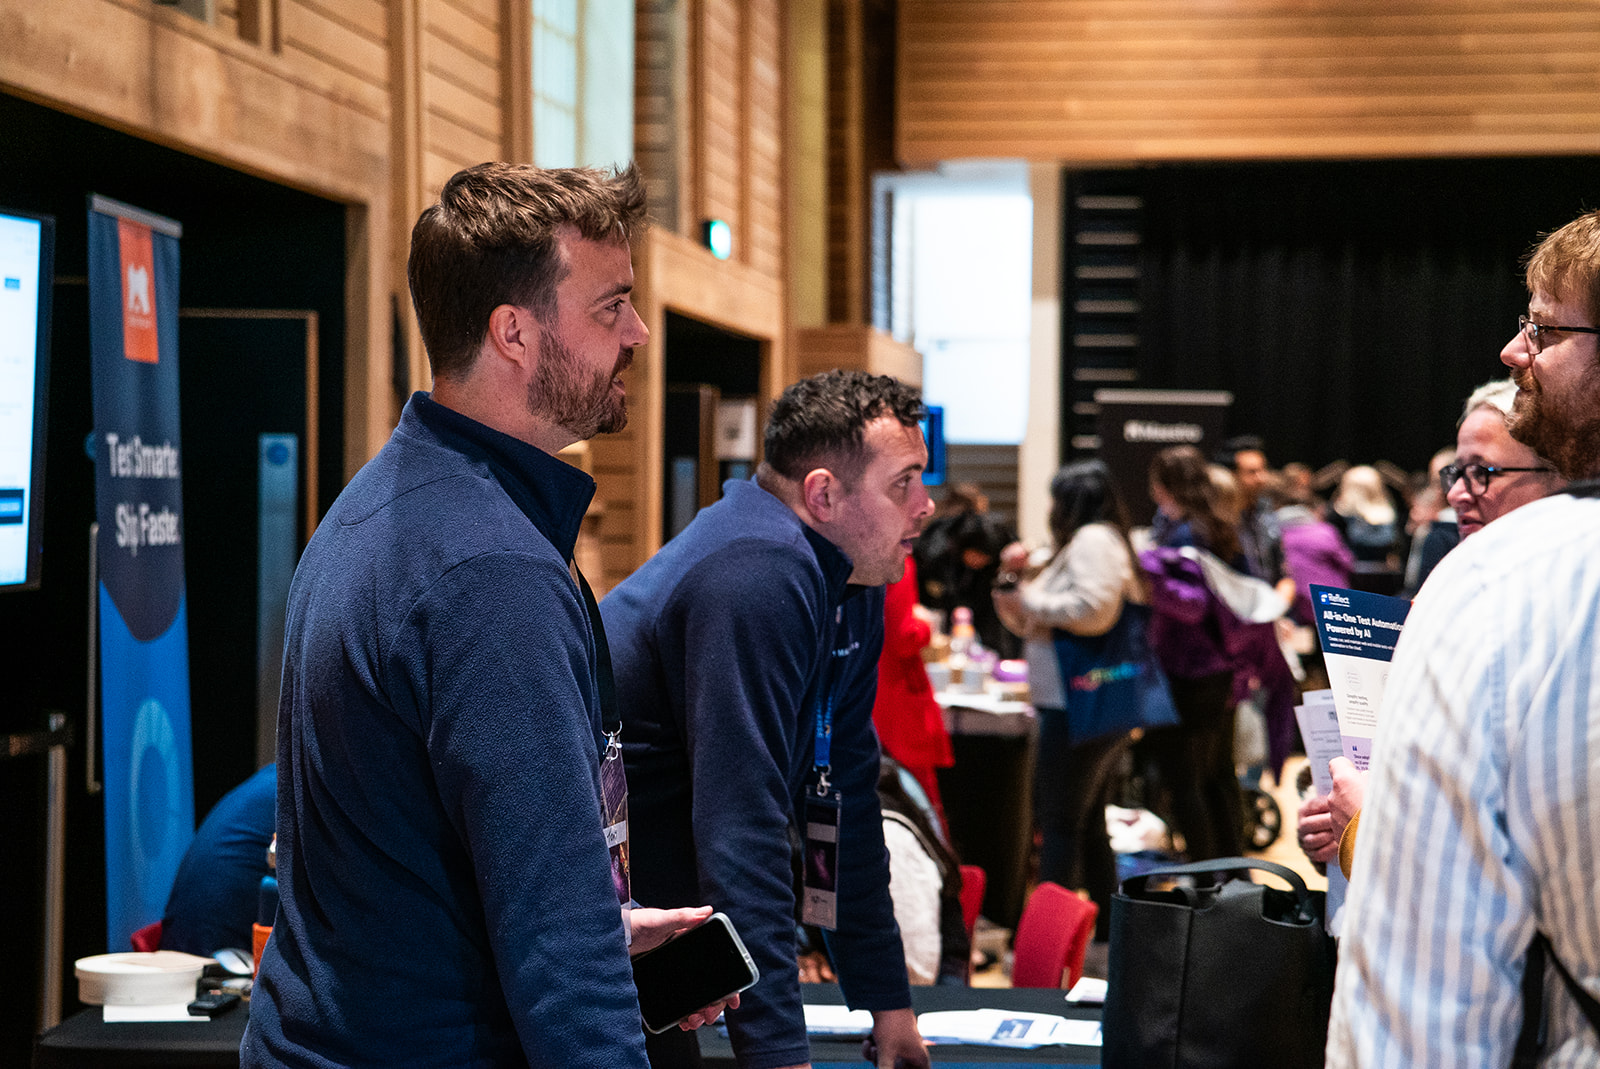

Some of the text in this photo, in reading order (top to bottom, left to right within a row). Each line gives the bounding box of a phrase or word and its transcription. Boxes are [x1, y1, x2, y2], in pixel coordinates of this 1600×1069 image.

[1328, 593, 1350, 604] Reflect
[1323, 611, 1357, 624] All-in-One
[1356, 615, 1371, 626] Test
[1325, 623, 1372, 638] Powered by AI
